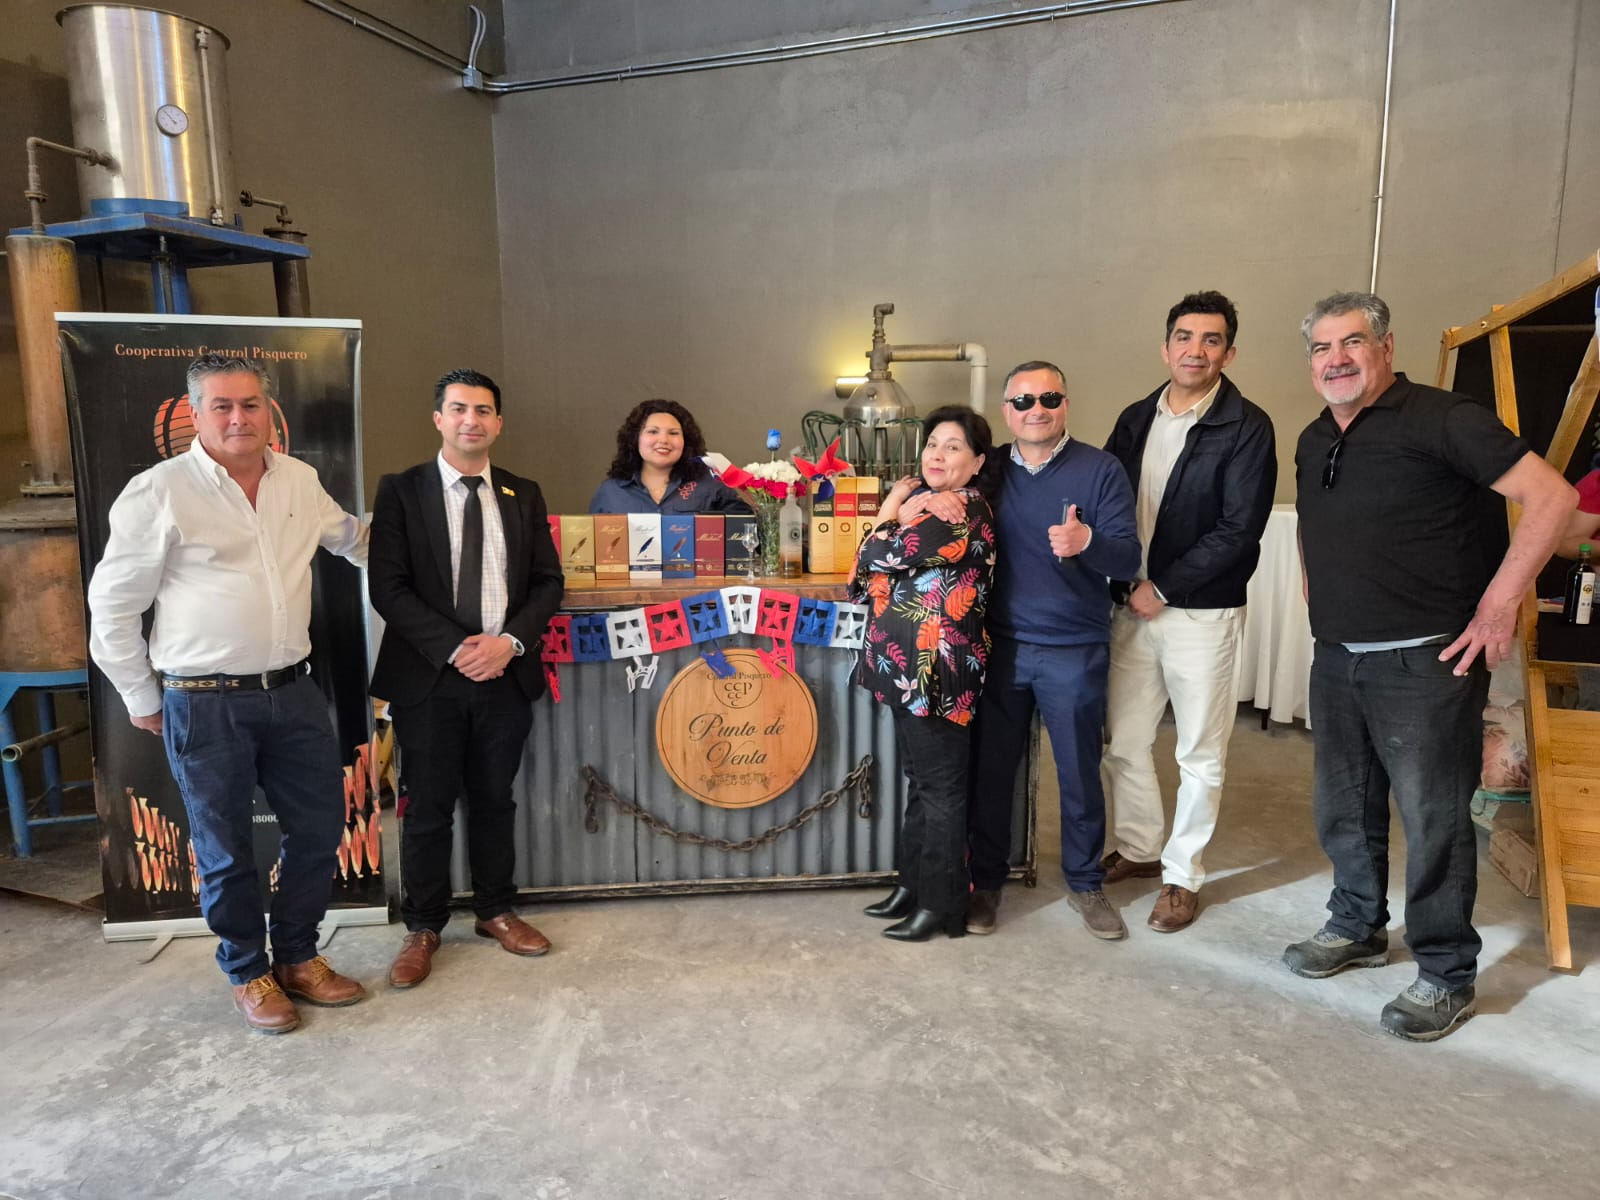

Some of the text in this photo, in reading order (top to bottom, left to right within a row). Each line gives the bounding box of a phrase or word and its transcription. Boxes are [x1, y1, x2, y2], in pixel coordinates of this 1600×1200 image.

[115, 343, 194, 360] Cooperativa
[253, 346, 308, 364] Pisquero
[688, 713, 785, 742] Punto de
[706, 740, 768, 769] Venta
